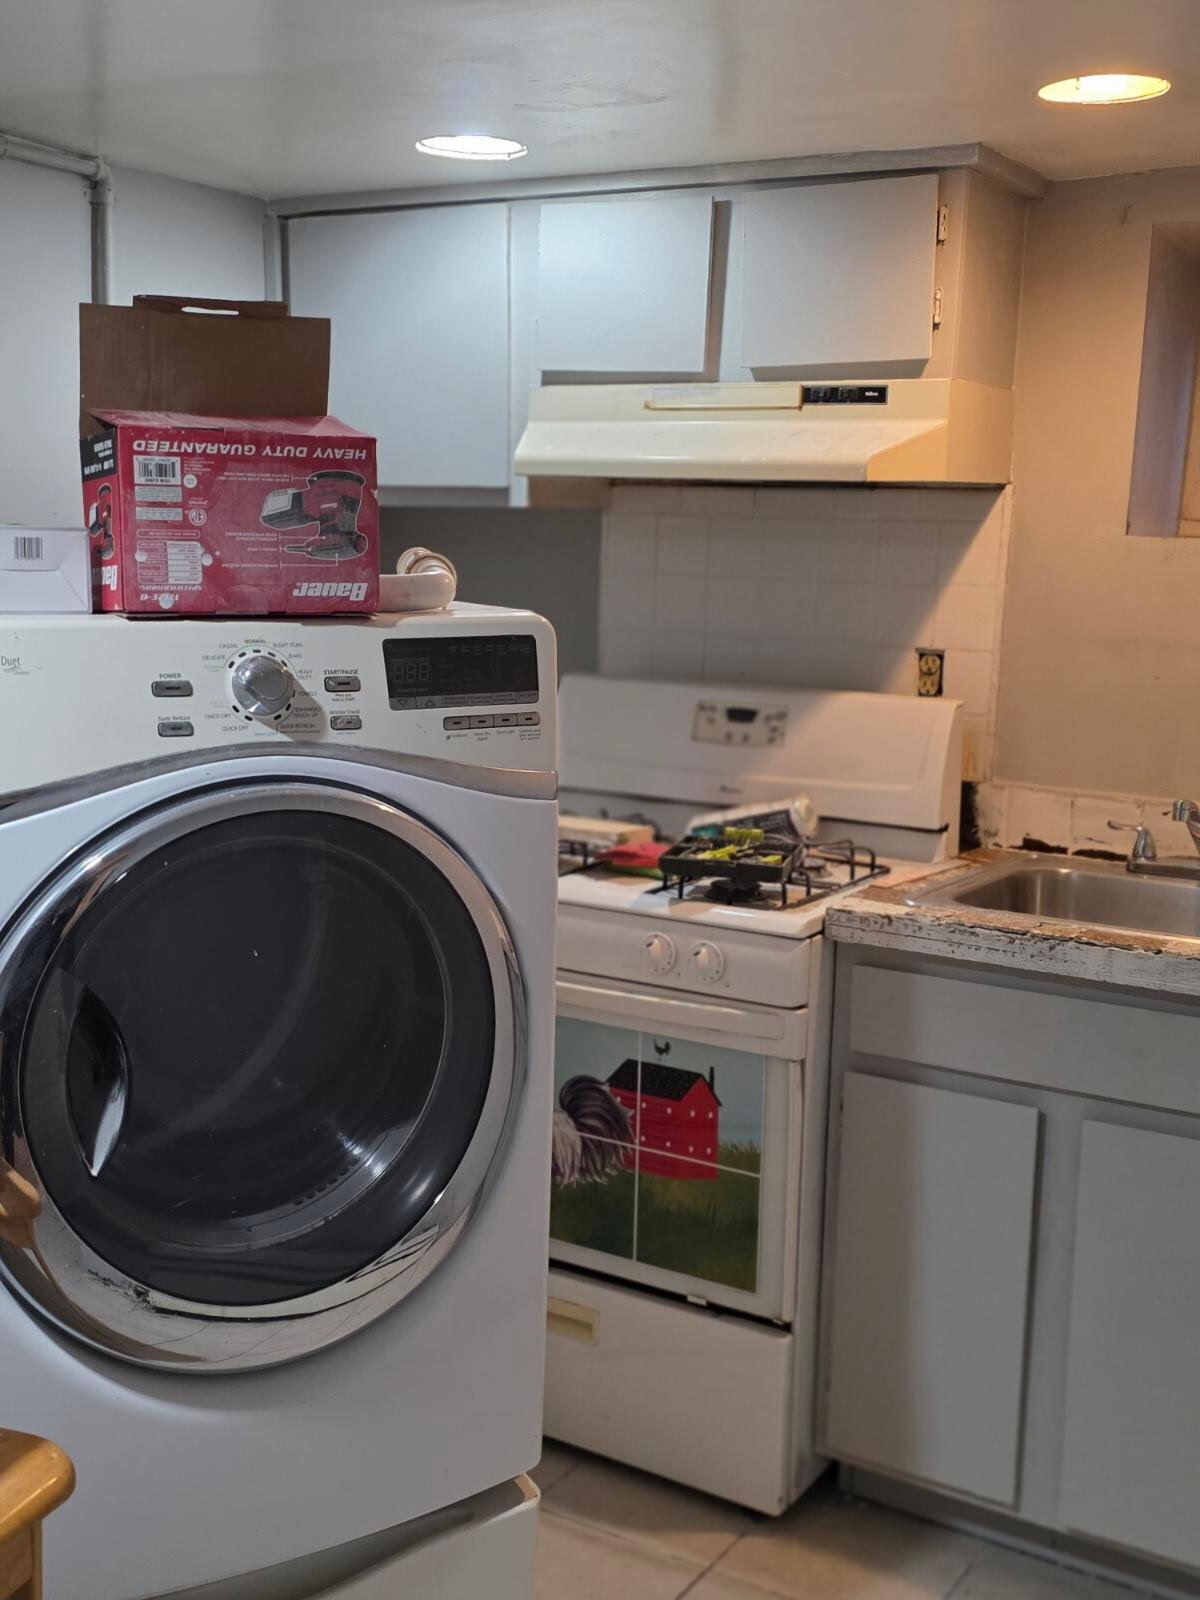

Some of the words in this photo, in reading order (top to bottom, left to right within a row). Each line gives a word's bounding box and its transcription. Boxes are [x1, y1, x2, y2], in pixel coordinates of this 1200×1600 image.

[132, 439, 256, 456] GUARANTEED
[262, 445, 307, 457] DUTY
[313, 447, 367, 459] HEAVY
[292, 582, 368, 601] Bauer
[0, 655, 21, 666] Duet
